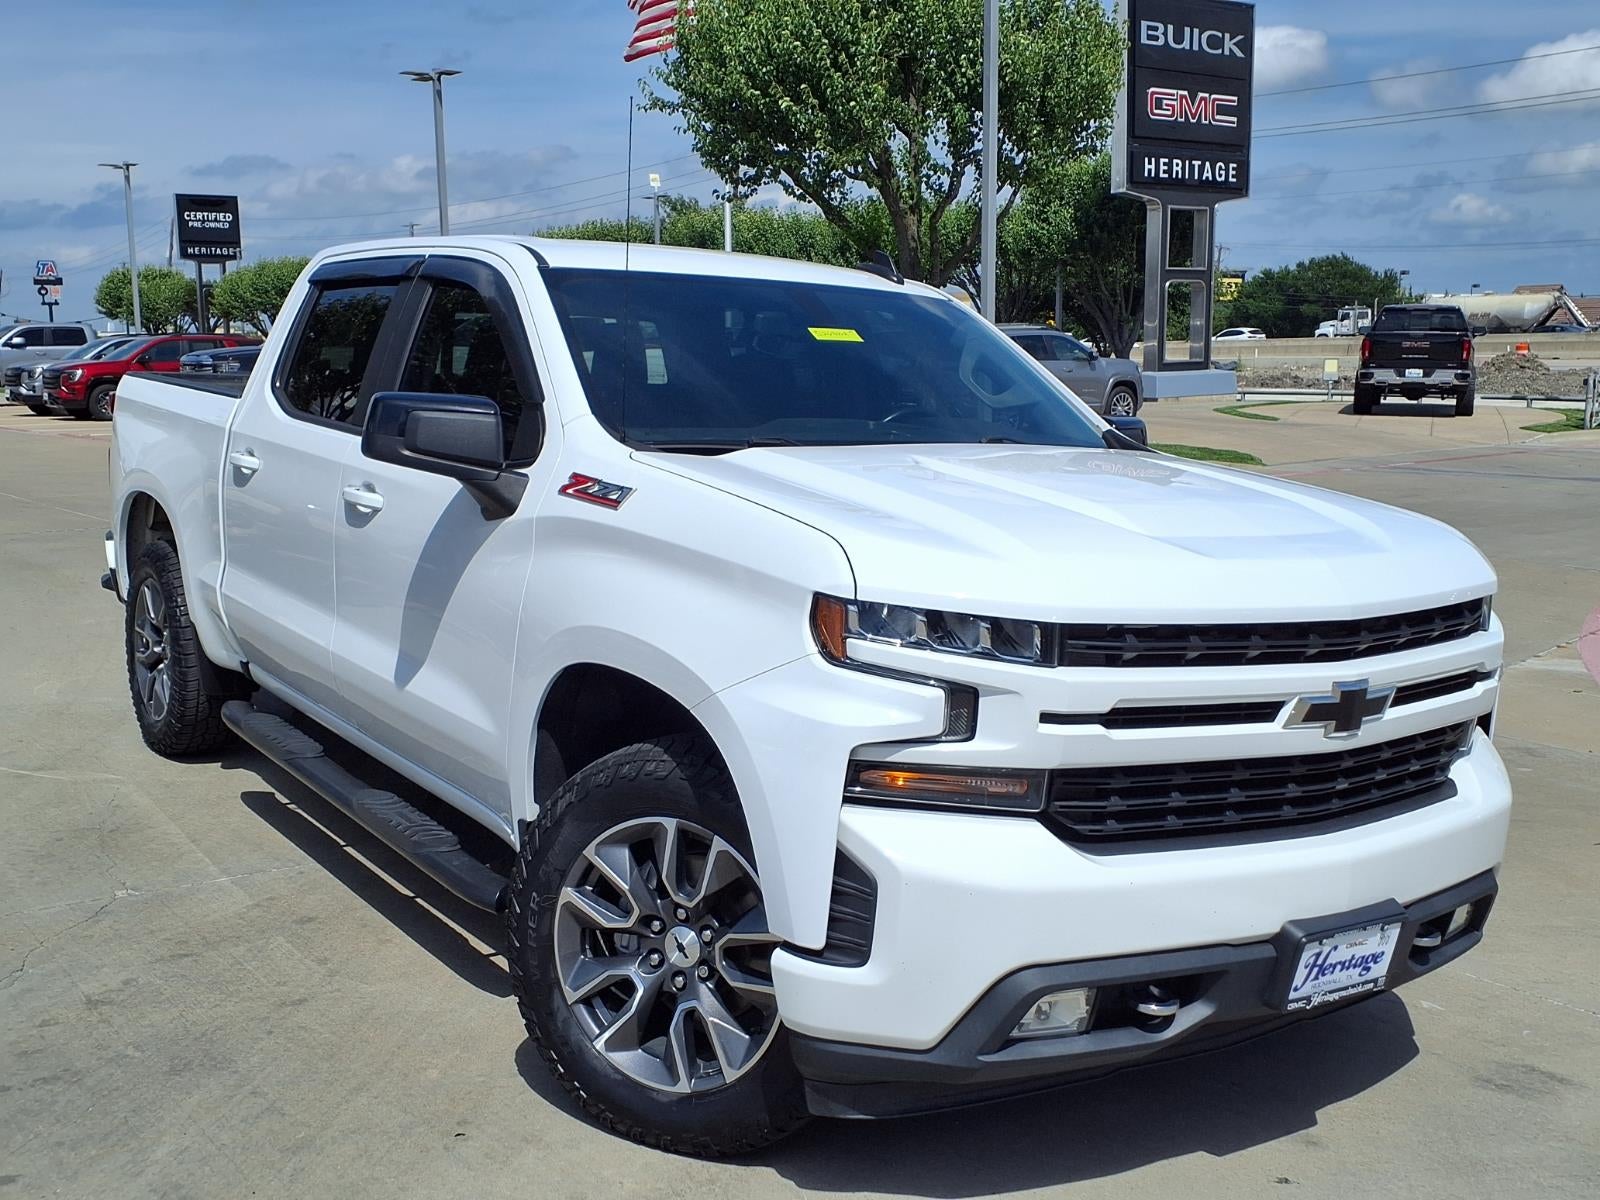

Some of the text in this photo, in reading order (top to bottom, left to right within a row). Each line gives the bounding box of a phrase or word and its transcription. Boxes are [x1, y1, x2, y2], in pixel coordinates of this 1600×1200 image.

[1140, 20, 1245, 57] BUICK
[1147, 87, 1238, 127] GMC
[1144, 157, 1237, 182] HERITAGE
[184, 211, 233, 222] CERTIFIED
[188, 221, 229, 229] PRE-OWNED
[187, 247, 235, 256] HERITAGE
[36, 260, 58, 276] TA
[558, 472, 637, 511] Z71
[1292, 944, 1386, 993] Heritage
